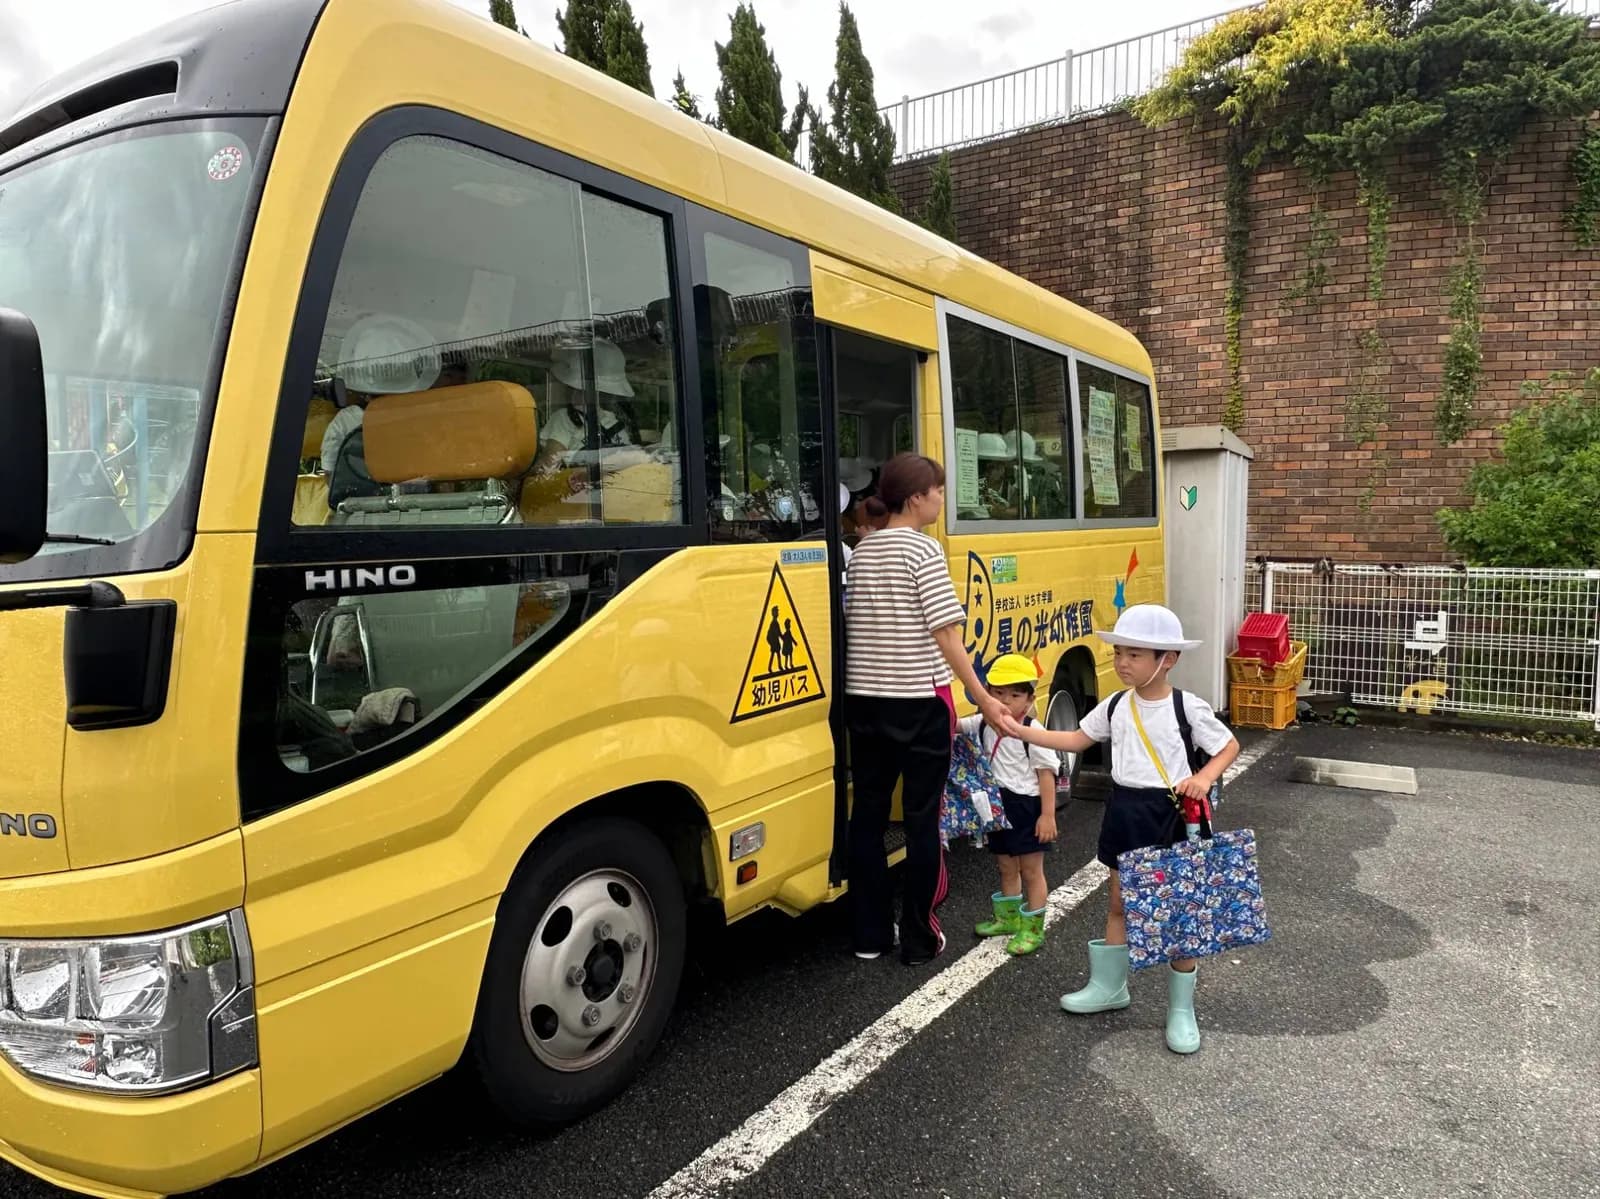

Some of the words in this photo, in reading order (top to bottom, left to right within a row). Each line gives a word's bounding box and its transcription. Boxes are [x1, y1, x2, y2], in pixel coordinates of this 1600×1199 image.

[305, 565, 416, 591] HINO
[995, 595, 1021, 613] 学校法人
[1024, 590, 1053, 608] はちす学園
[996, 600, 1094, 653] 星の光幼稚園
[752, 675, 808, 707] 幼児バス
